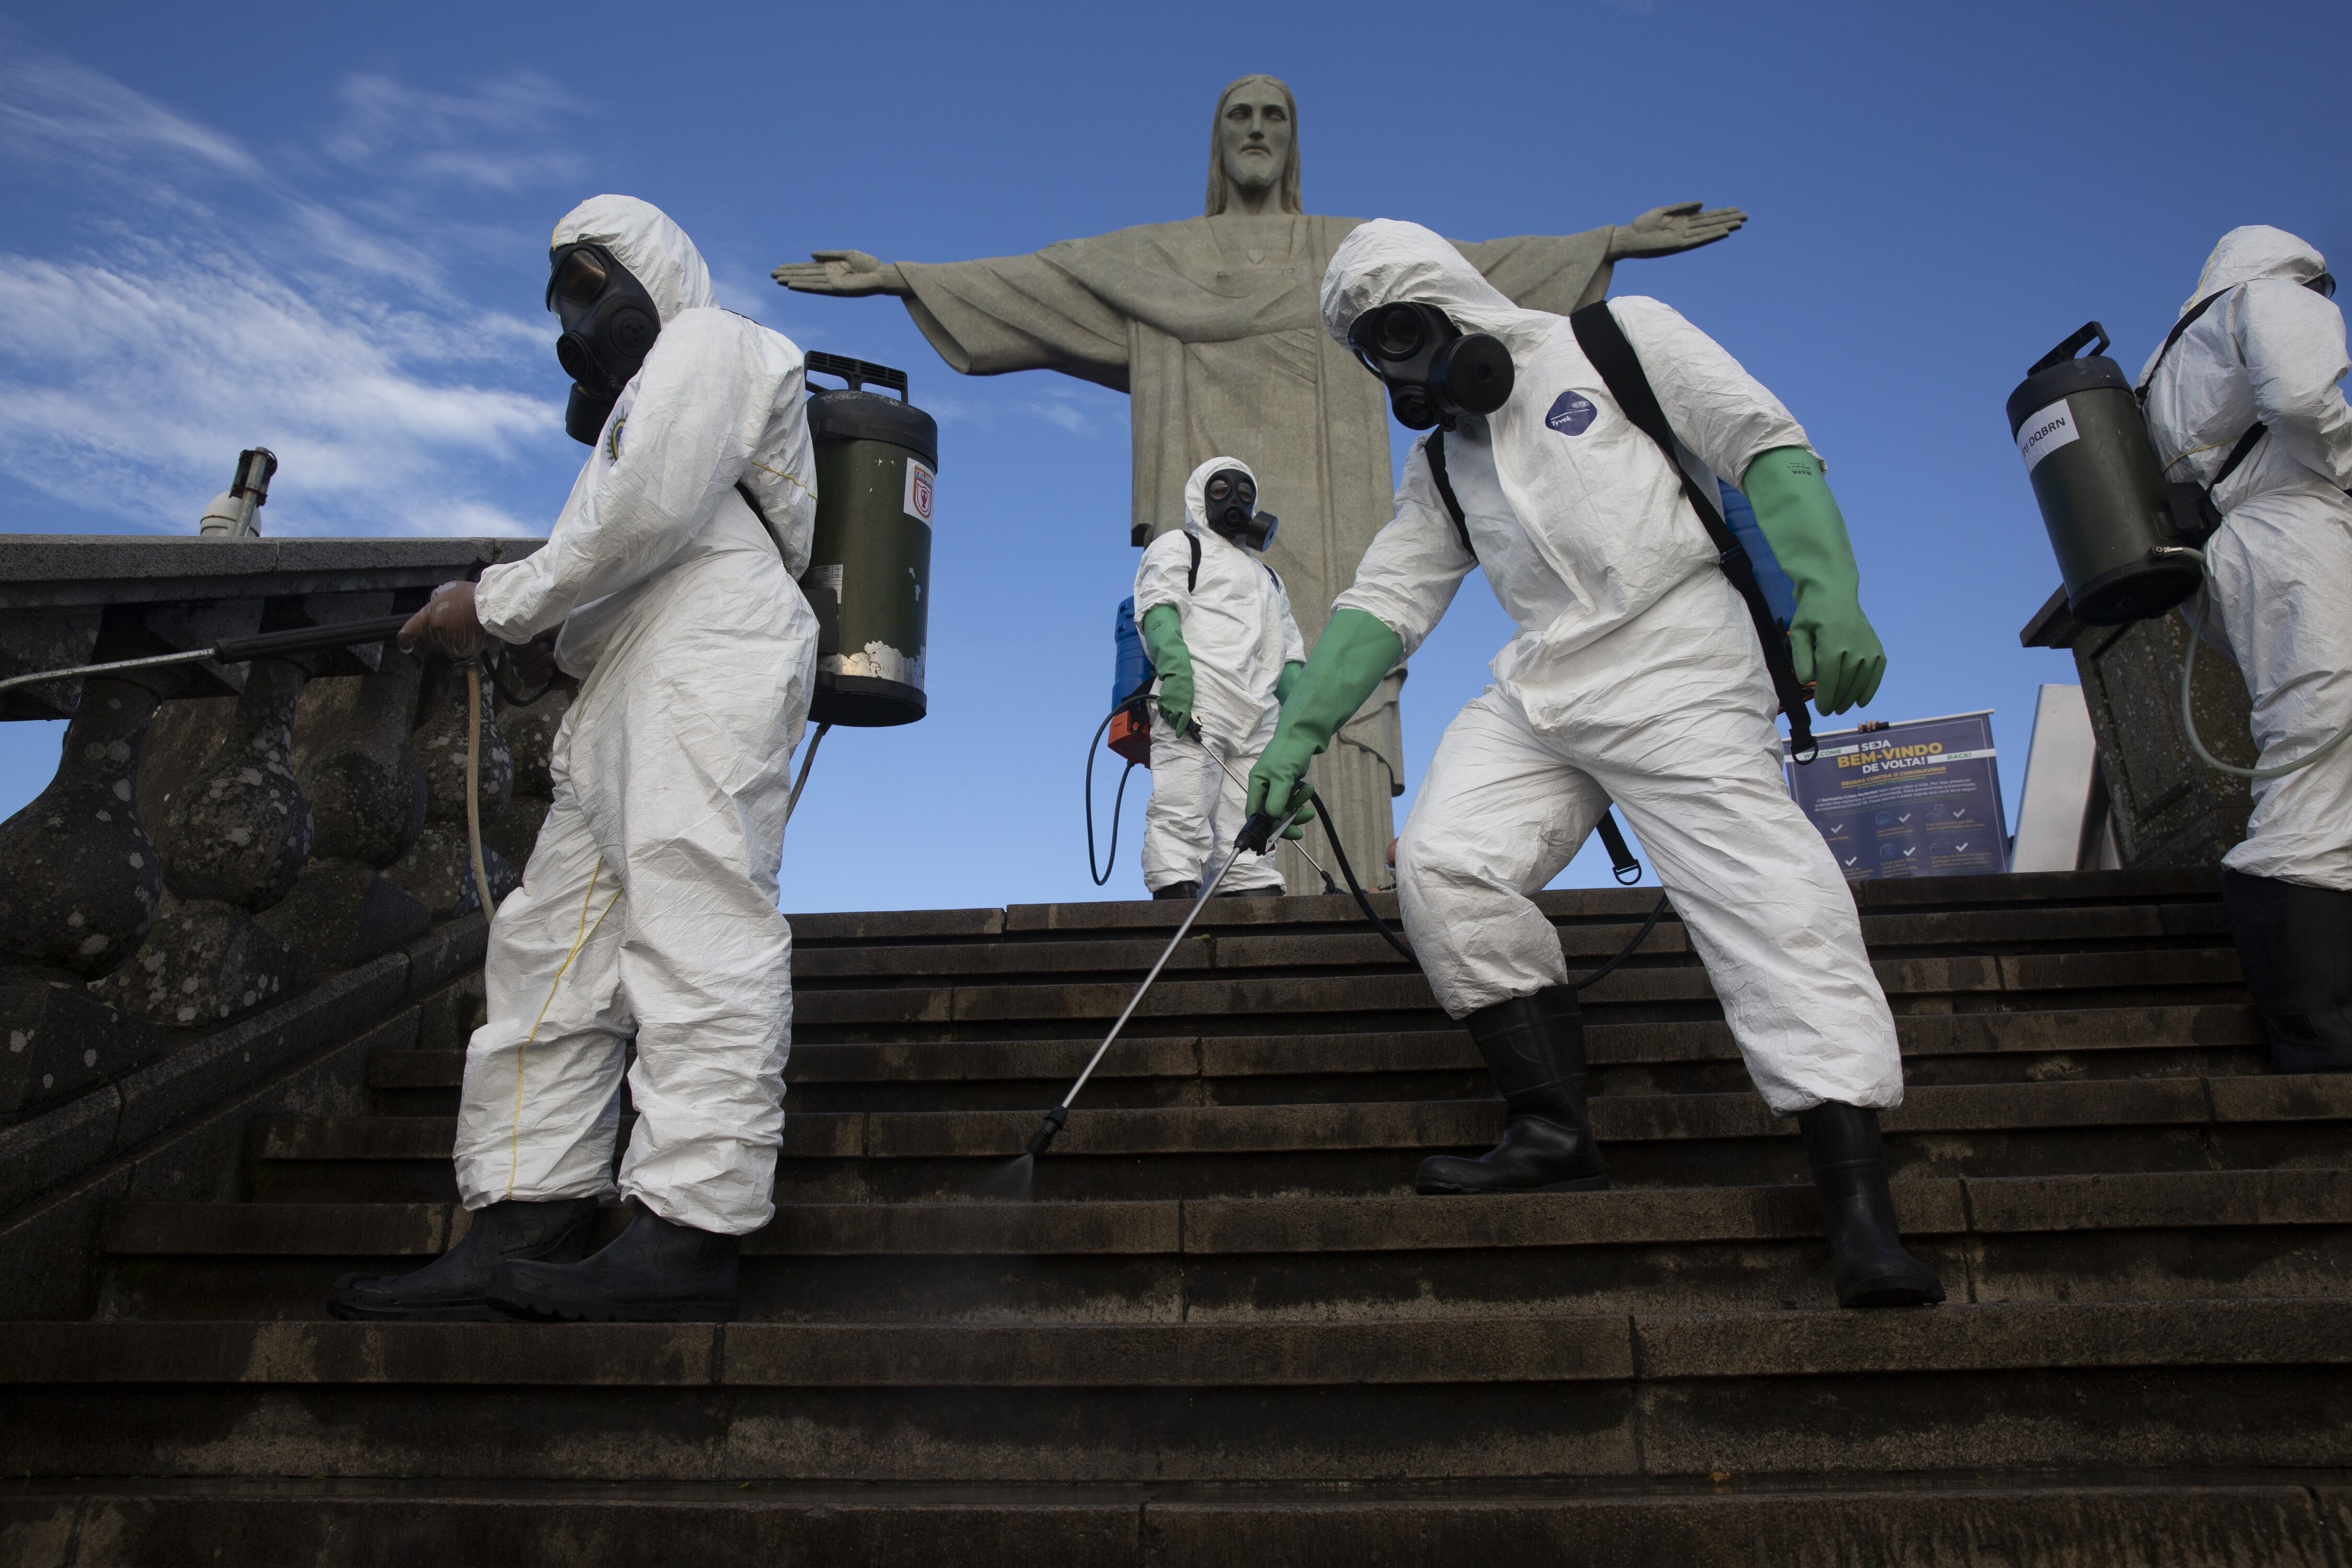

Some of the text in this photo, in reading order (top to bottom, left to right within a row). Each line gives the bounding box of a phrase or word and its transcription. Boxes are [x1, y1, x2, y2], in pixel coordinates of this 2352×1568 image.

[1551, 416, 1571, 426] Tyvek
[2028, 417, 2066, 447] DQBRN
[1861, 740, 1891, 751] SEJA
[1837, 742, 1943, 768] BEM-VINDO
[1862, 756, 1925, 774] DE VOLTA!
[1866, 773, 1892, 782] CONTRA
